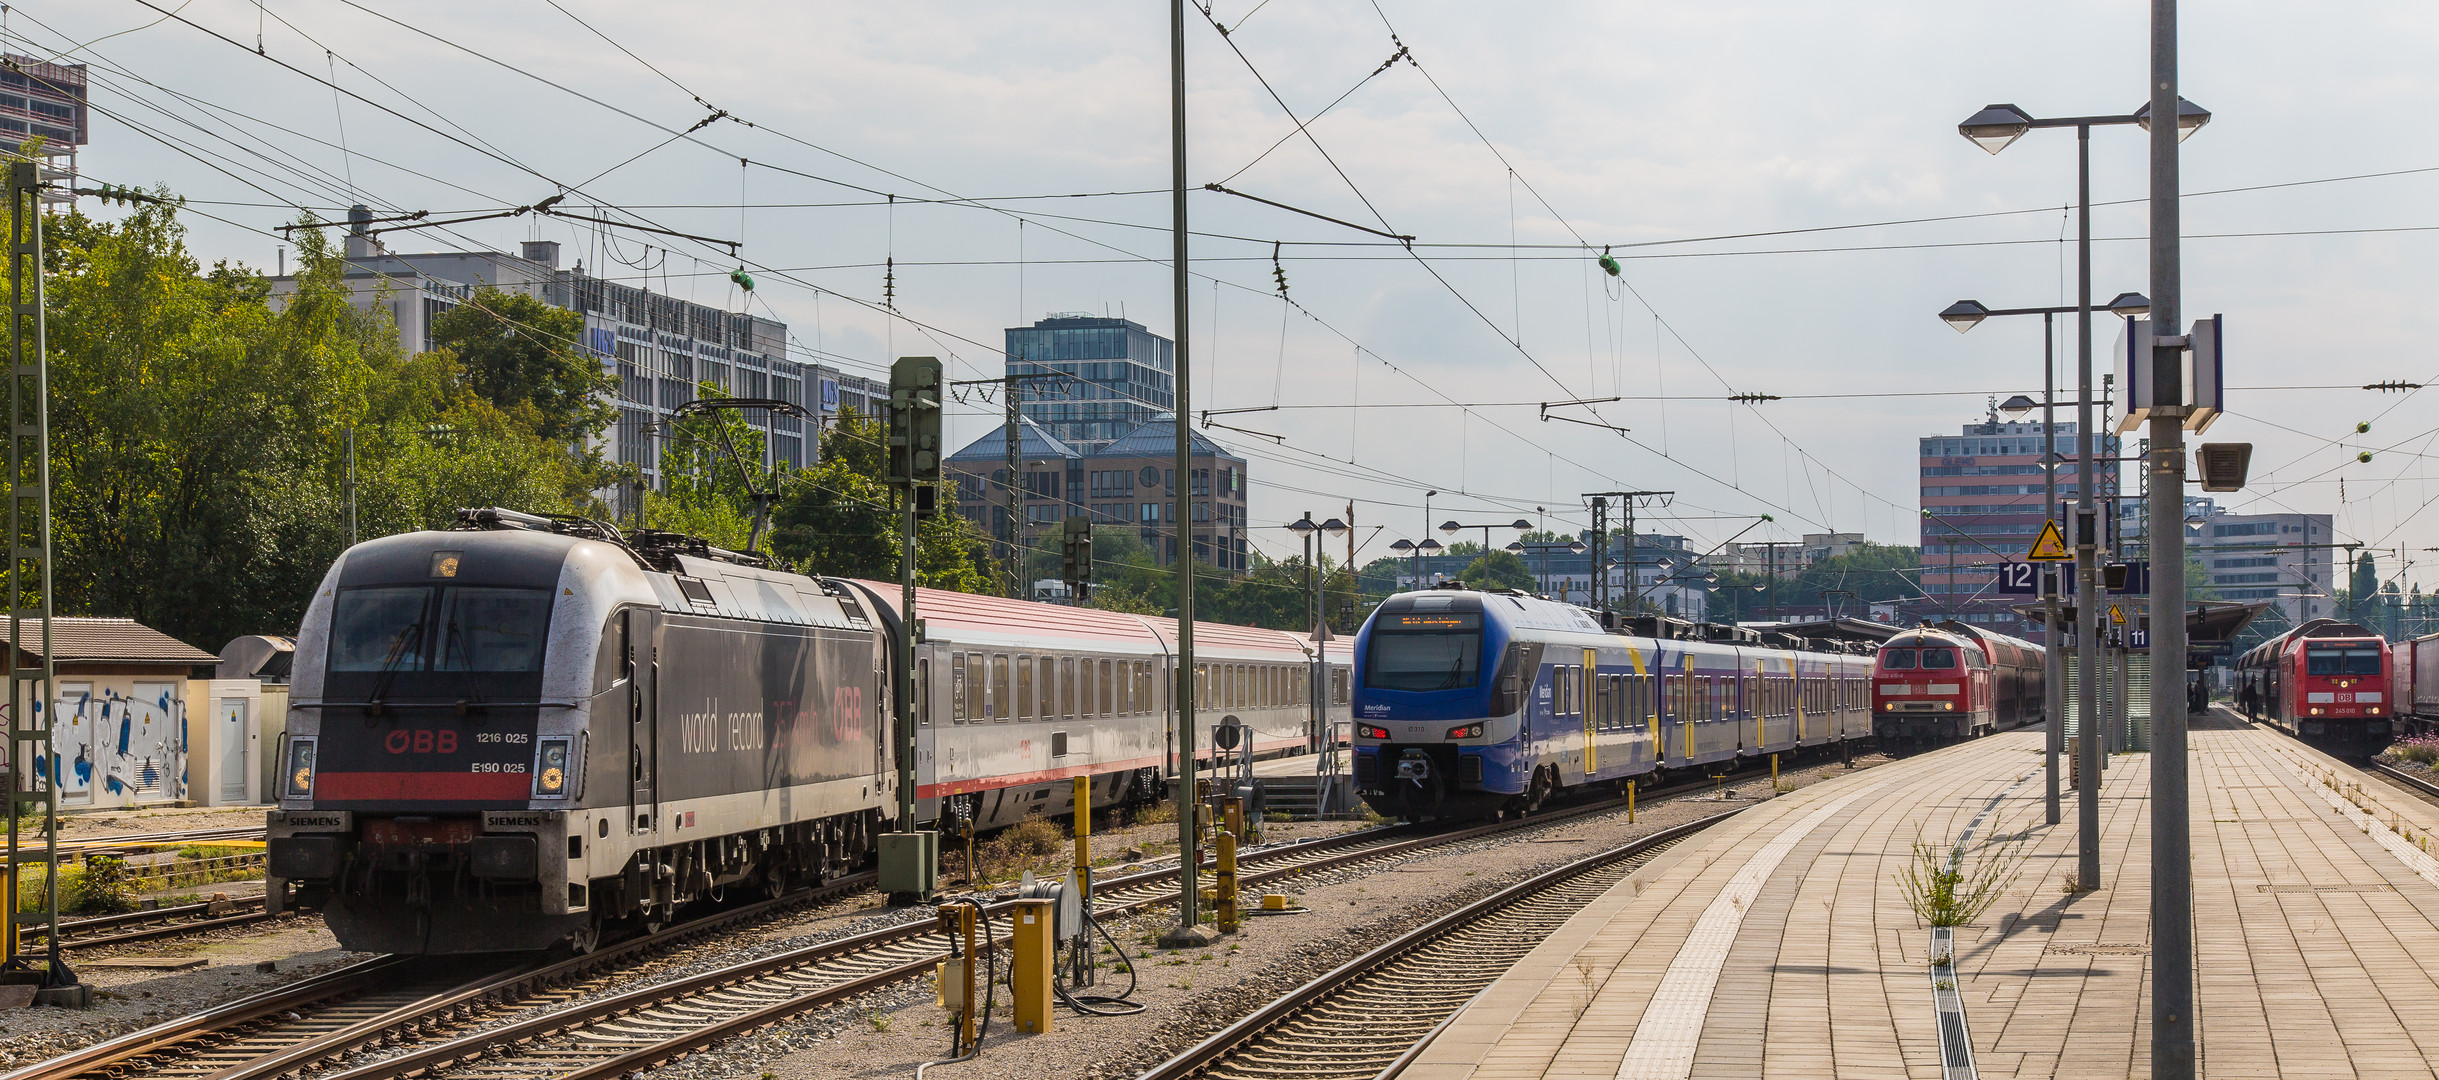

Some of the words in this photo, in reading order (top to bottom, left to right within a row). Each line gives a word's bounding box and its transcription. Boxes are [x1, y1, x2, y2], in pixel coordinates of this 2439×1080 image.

[2003, 563, 2031, 586] 12
[2132, 630, 2145, 645] 11
[986, 659, 992, 694] 2
[2338, 694, 2351, 702] DB
[681, 696, 718, 754] world
[728, 696, 764, 751] record
[773, 700, 792, 749] 357
[833, 686, 862, 742] ÖBB
[385, 729, 458, 754] ÖBB
[476, 733, 501, 743] 1216
[505, 733, 528, 744] 025
[471, 763, 500, 773] E190
[503, 763, 526, 773] 025
[289, 816, 341, 827] SIEMENS
[487, 816, 541, 827] SIEMENS
